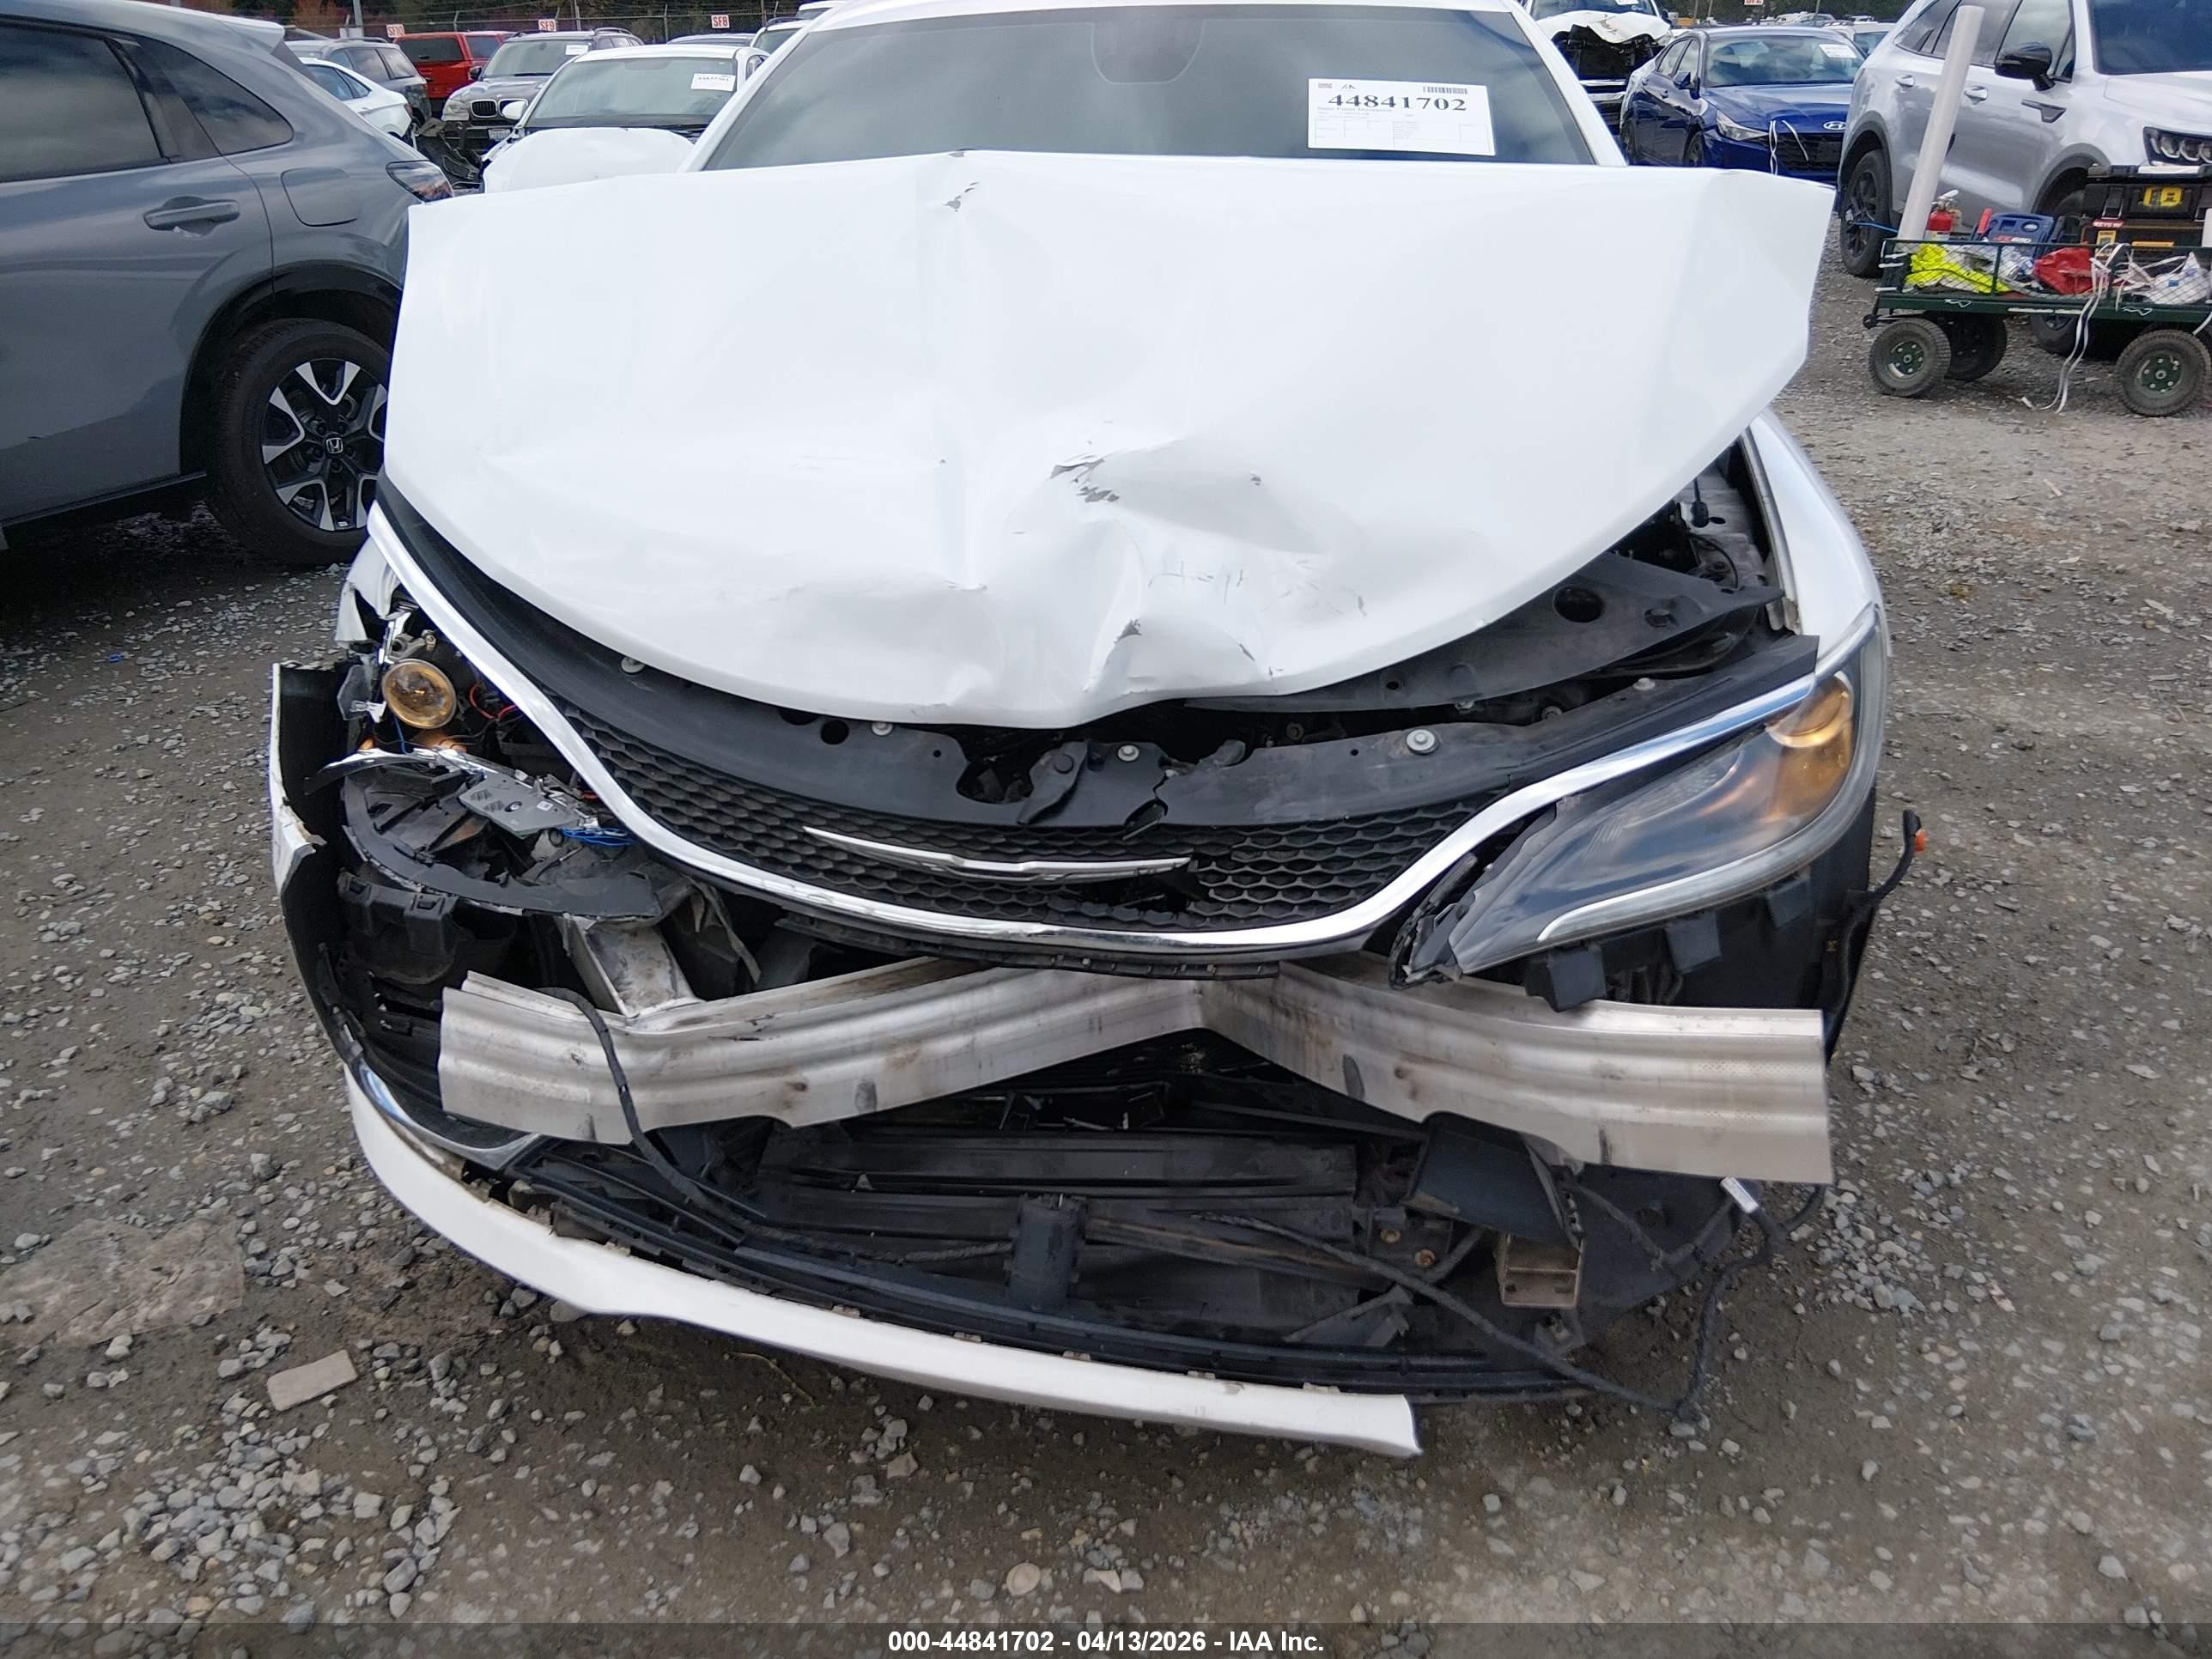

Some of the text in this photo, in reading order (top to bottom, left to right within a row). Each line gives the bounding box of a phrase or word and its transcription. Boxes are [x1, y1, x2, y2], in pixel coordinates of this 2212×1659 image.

[539, 21, 555, 31] SF9
[713, 16, 728, 27] SF8
[1328, 94, 1468, 112] 44841702
